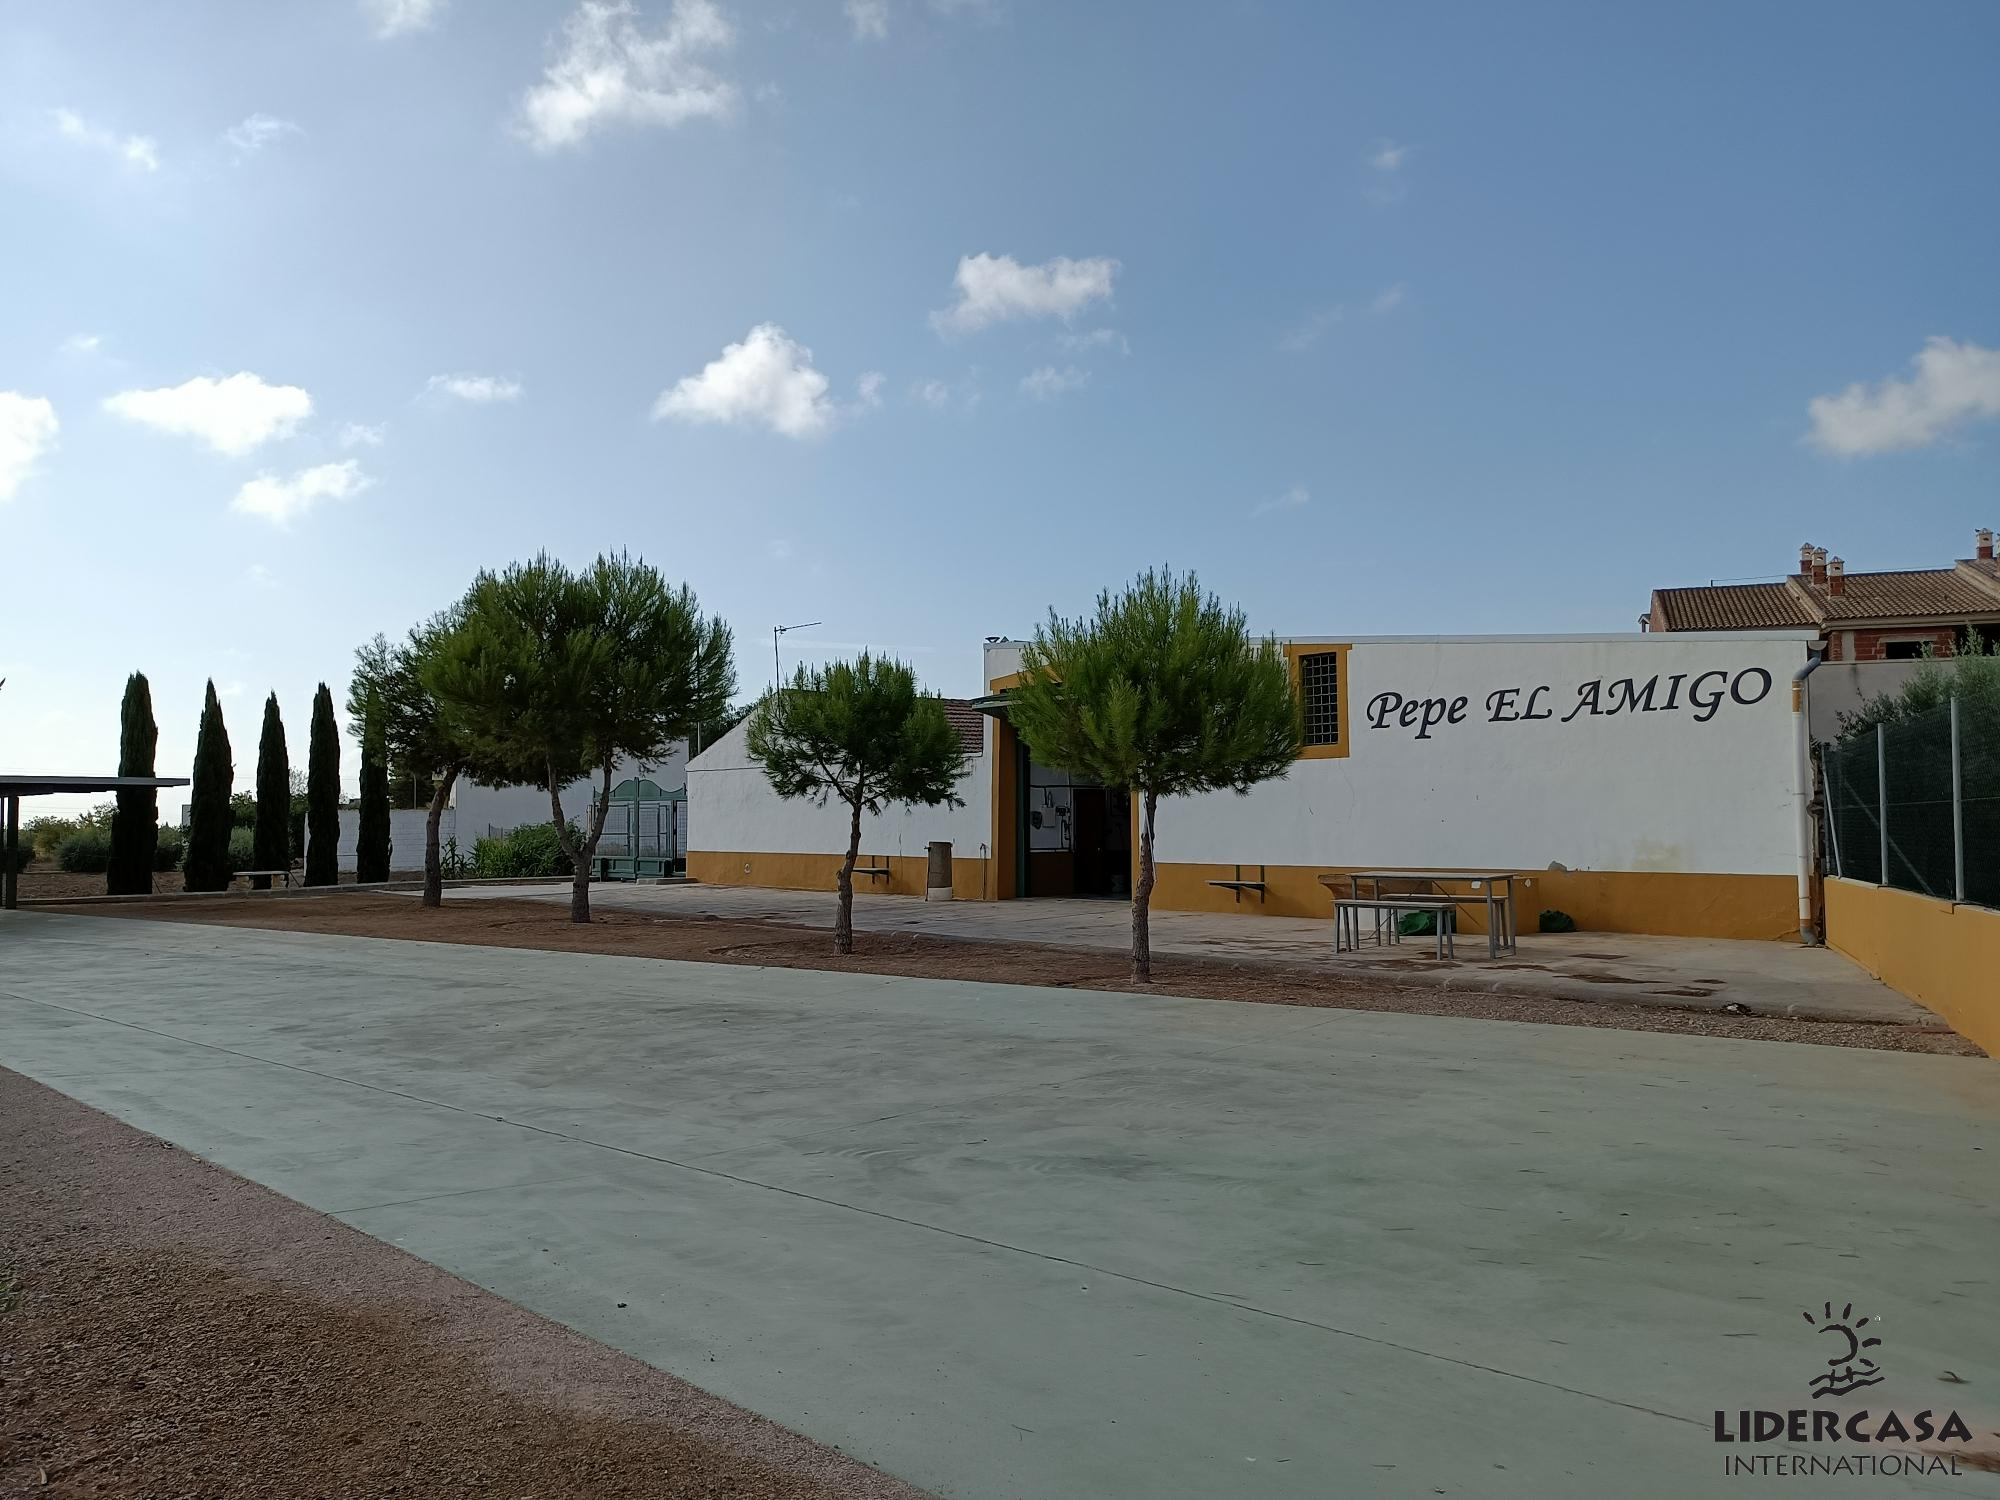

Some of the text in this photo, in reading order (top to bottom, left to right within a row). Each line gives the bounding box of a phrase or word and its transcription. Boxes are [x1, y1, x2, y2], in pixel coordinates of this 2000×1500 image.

[1366, 667, 1773, 739] Pepe EL AMIGO
